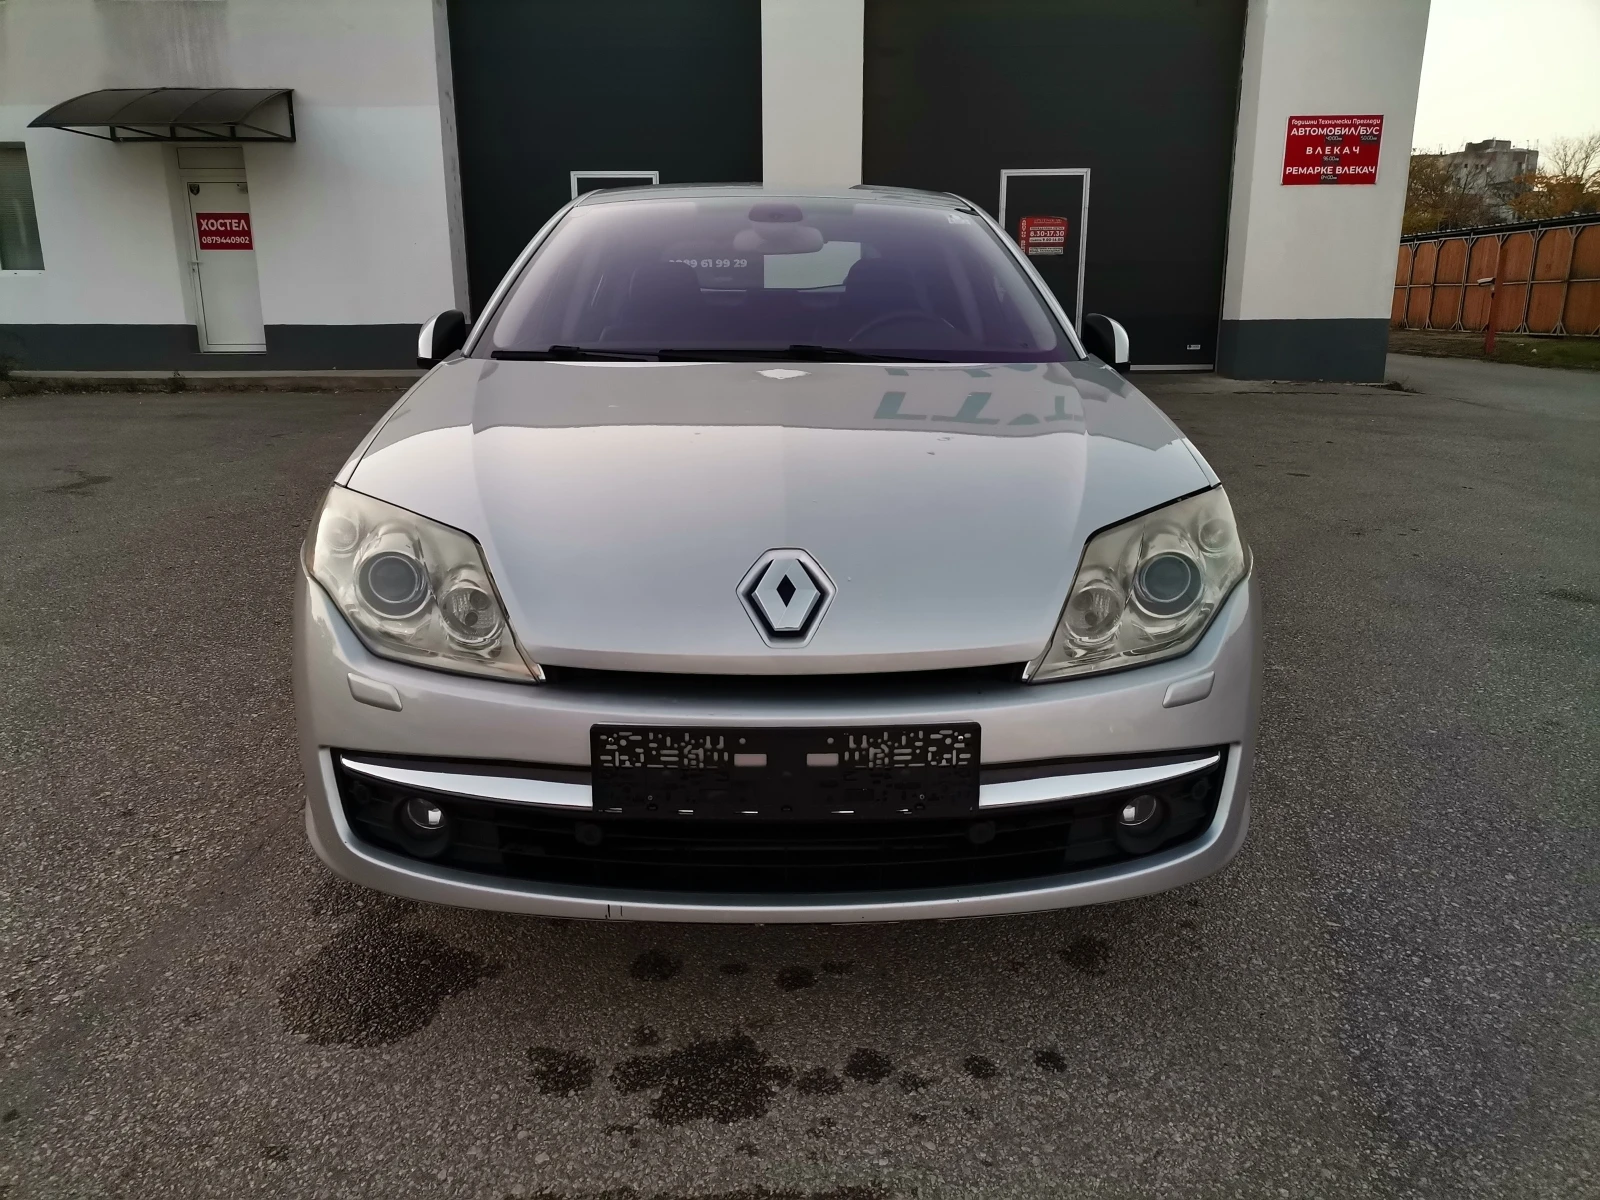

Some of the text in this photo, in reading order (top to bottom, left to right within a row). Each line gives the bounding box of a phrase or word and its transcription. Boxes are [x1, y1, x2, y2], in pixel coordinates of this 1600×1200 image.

[1291, 126, 1380, 135] АВТОМОБИЛ/БУС
[1286, 165, 1376, 175] РЕМАРКЕ ВЛЕКАЧ
[200, 219, 248, 231] ХОСТЕЛ
[202, 236, 250, 244] 0879440902
[701, 259, 713, 268] 61
[716, 259, 731, 268] 99
[734, 259, 748, 268] 29
